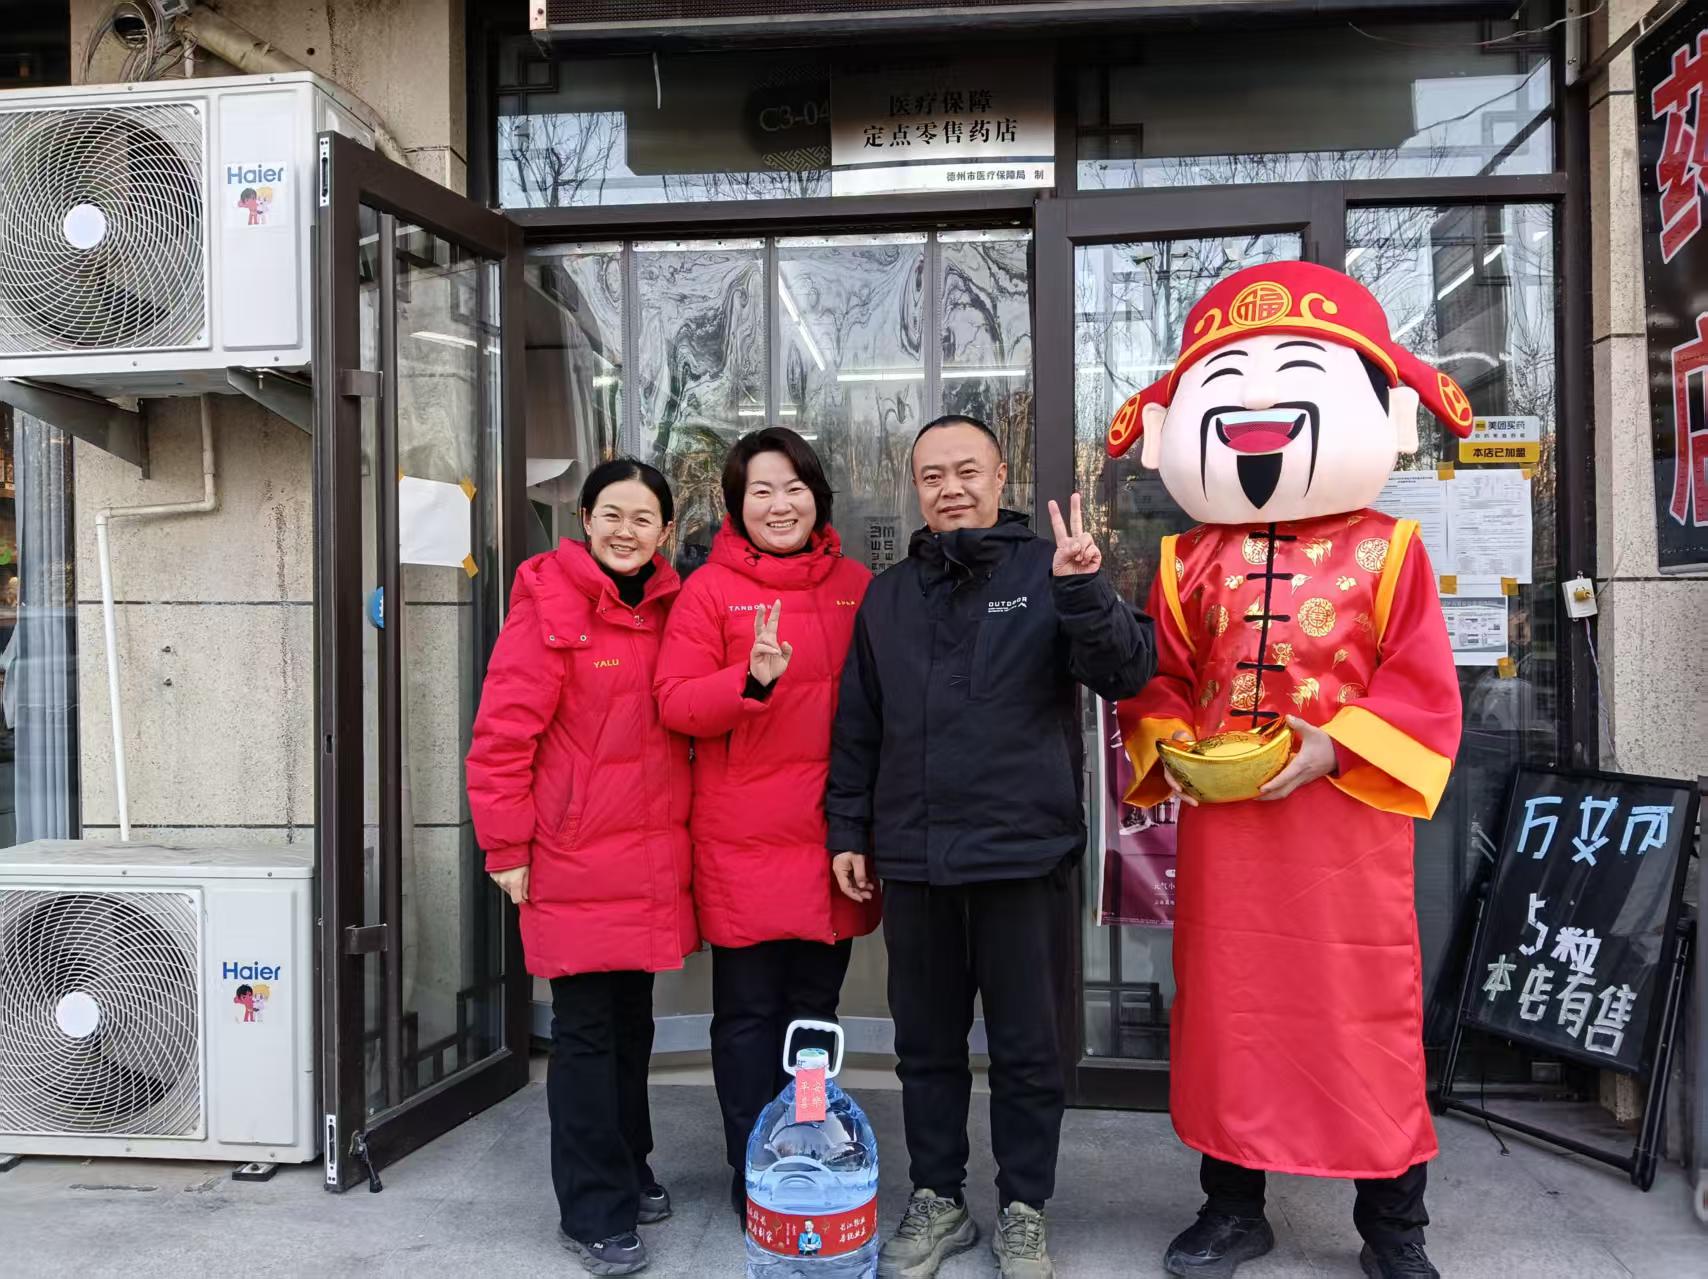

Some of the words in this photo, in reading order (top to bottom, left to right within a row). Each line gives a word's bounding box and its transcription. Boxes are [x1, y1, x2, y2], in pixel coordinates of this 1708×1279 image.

[889, 90, 992, 117] 医疗保障
[863, 118, 1018, 148] 定点零售药店
[227, 164, 284, 184] Haier
[946, 168, 1026, 182] 德州市医疗保障局
[1034, 169, 1044, 181] 制
[1235, 286, 1278, 323] 福
[1472, 447, 1526, 458] 本店已加盟
[988, 596, 1028, 607] OUTDOOR
[593, 658, 620, 669] YALU
[222, 961, 281, 980] Haier
[1481, 954, 1638, 1057] 本店有售
